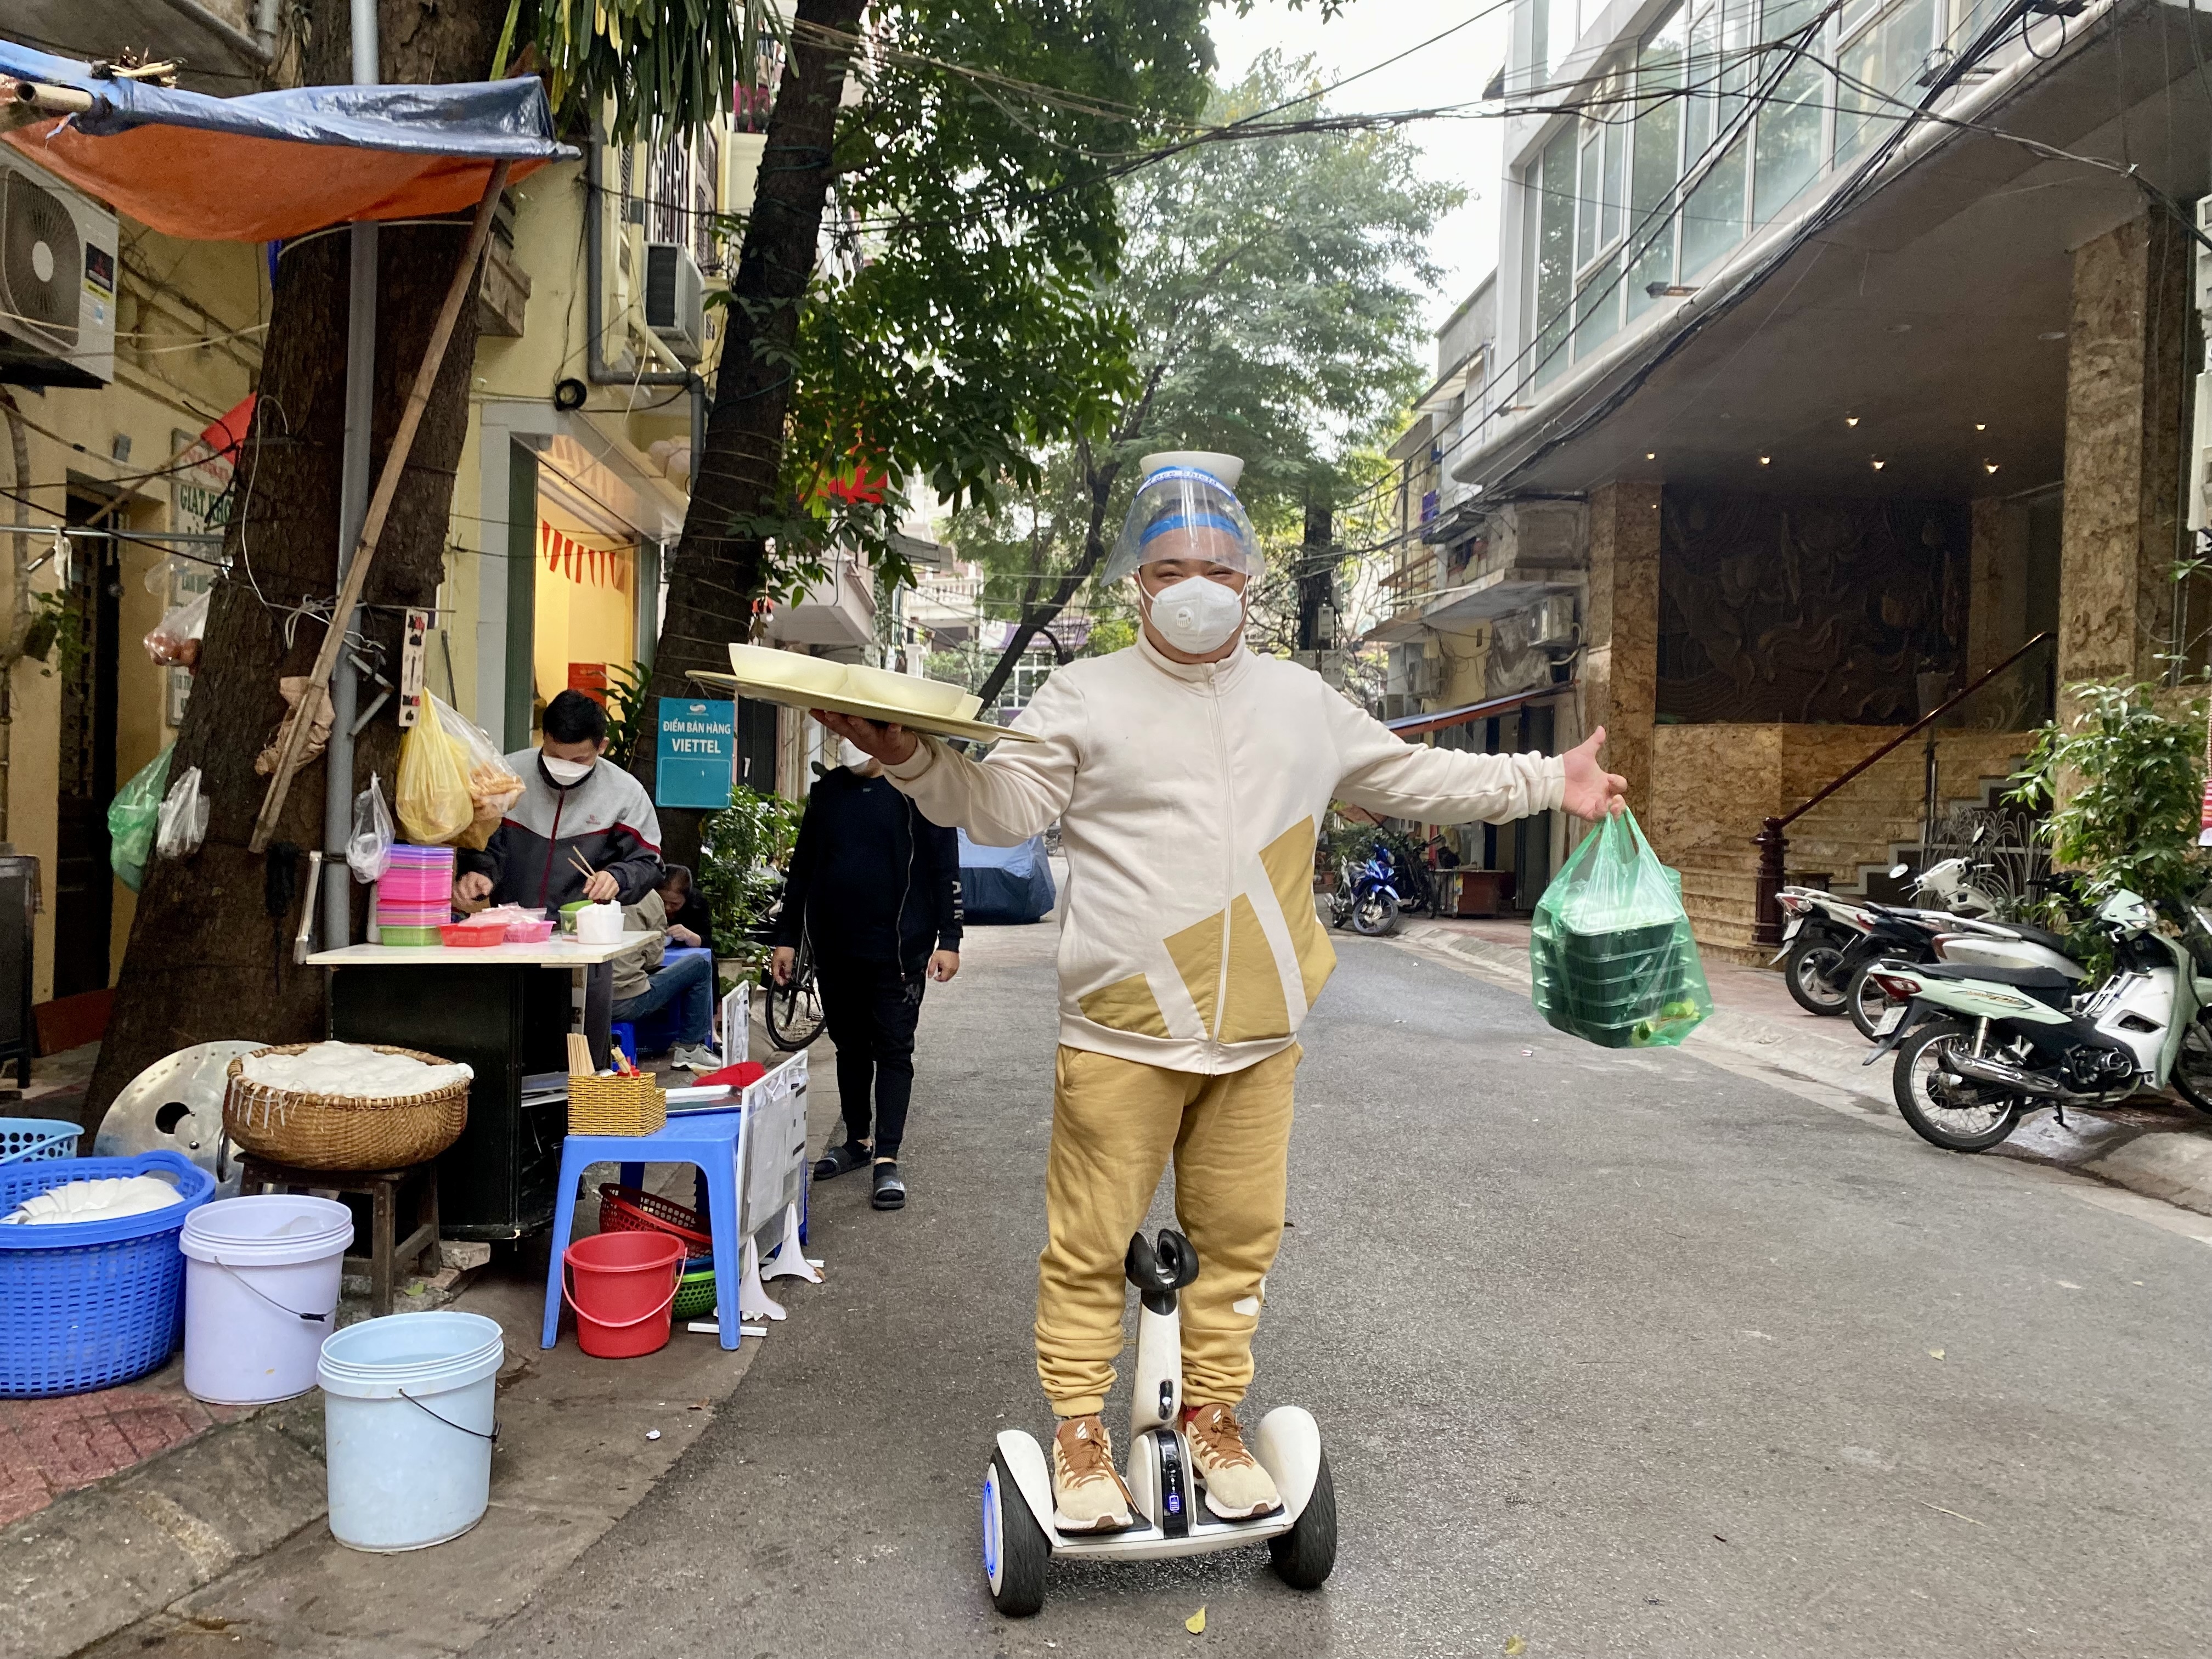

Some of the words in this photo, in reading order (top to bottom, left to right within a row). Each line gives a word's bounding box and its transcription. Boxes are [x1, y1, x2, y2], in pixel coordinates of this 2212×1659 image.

[663, 718, 685, 732] ĐIỂM
[686, 720, 704, 733] BÁN
[706, 721, 731, 735] HÀNG
[672, 738, 721, 754] VIETTEL
